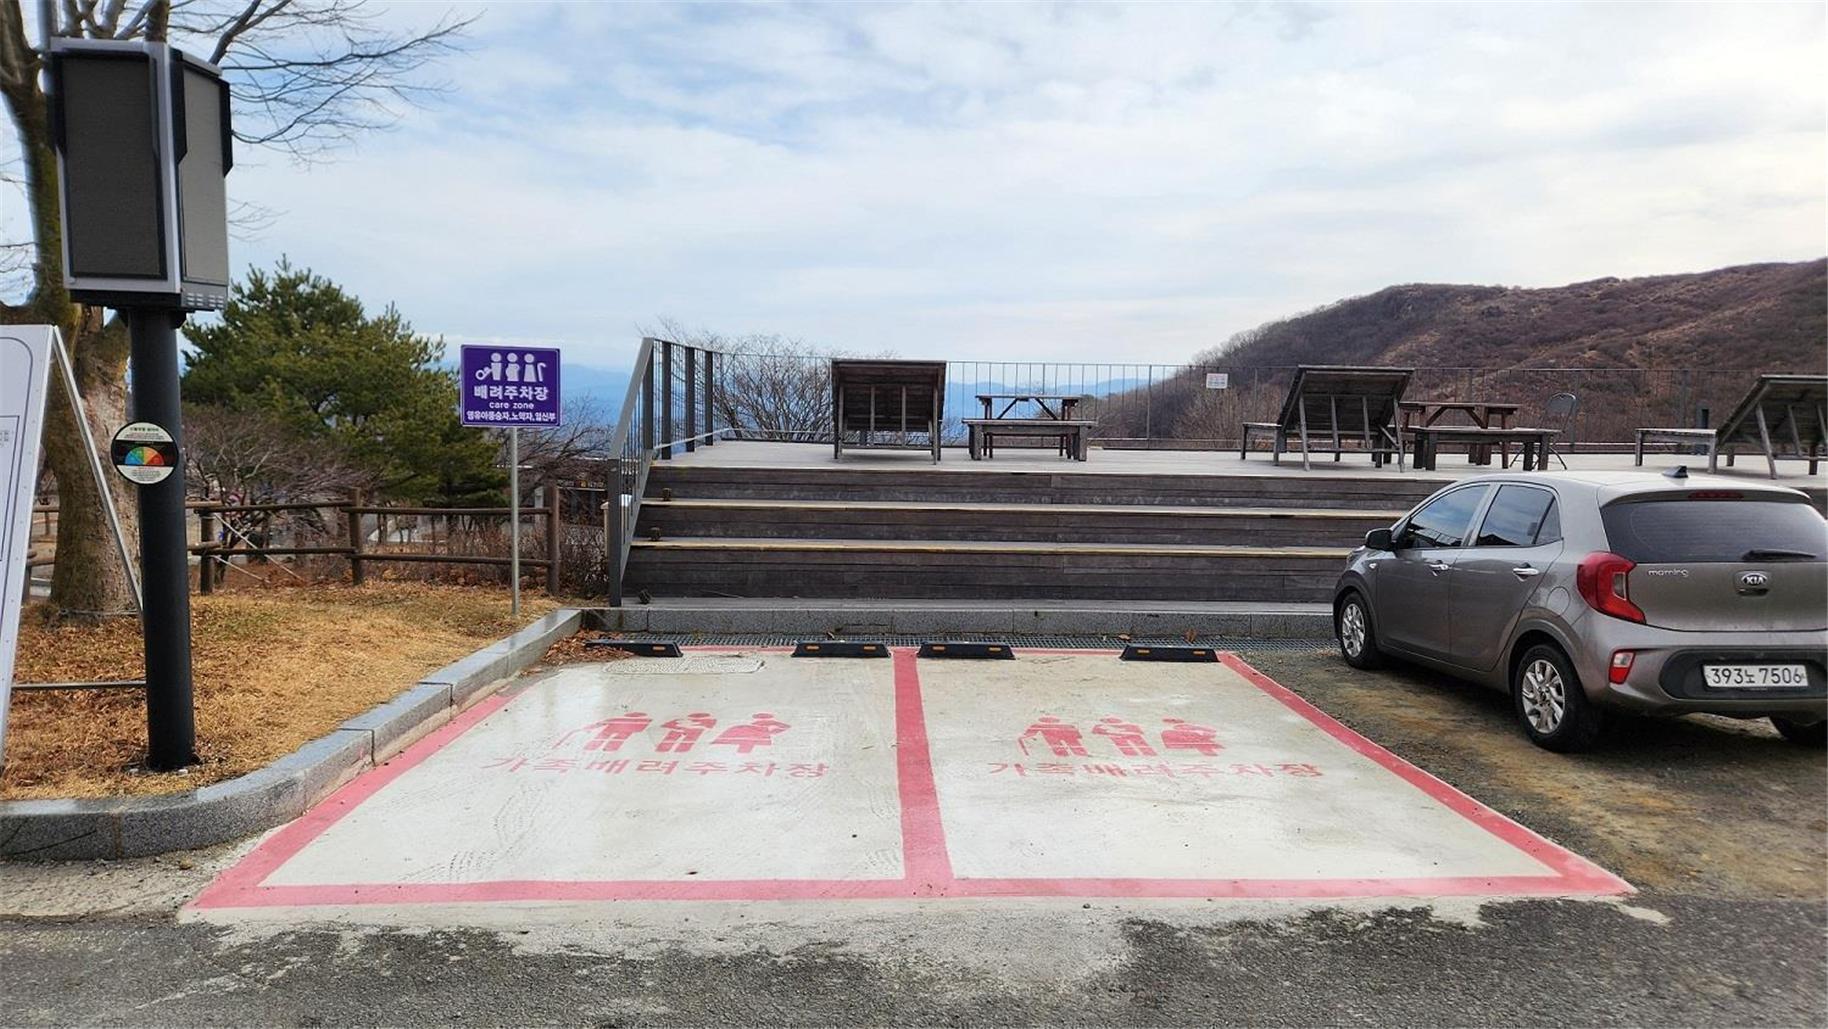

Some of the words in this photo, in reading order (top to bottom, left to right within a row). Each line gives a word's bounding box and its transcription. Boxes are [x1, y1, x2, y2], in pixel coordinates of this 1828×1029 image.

[473, 384, 549, 401] 배려주차장
[489, 401, 510, 409] care
[512, 402, 535, 410] zone
[1648, 568, 1689, 578] morning
[479, 756, 830, 779] 가족배려주차장
